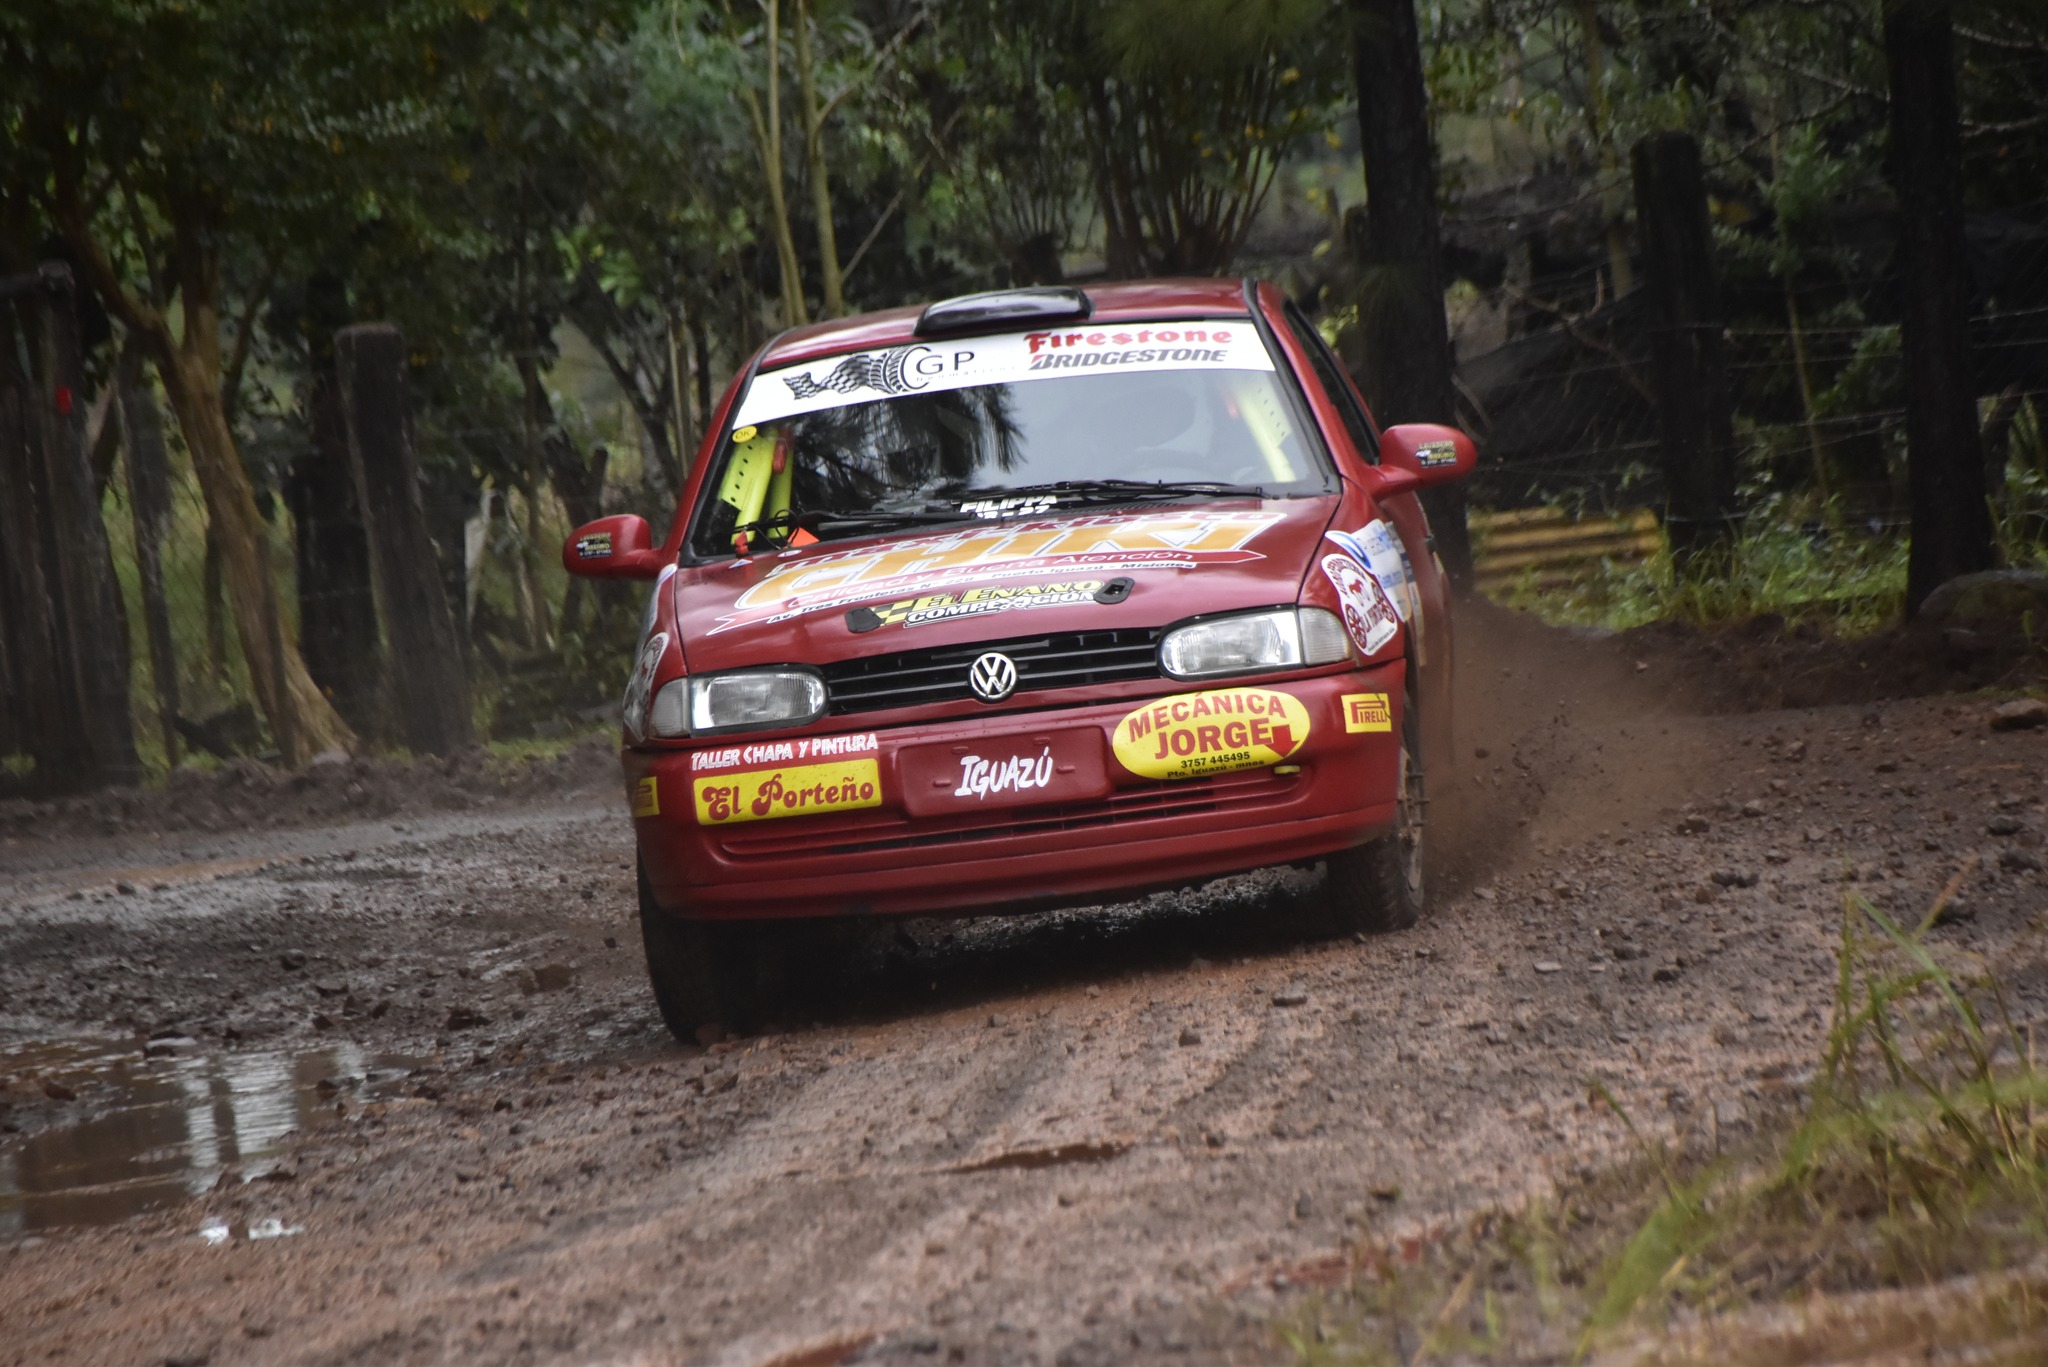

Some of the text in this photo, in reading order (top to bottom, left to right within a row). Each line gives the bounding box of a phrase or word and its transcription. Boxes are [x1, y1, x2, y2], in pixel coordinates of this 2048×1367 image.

[1023, 329, 1233, 354] Firestone
[1028, 348, 1228, 371] BRIDGESTONE
[960, 495, 1057, 513] FILIPPA
[787, 551, 1193, 609] Calidad y Buena Atención
[801, 603, 833, 613] Tres
[838, 585, 915, 604] Fronteras
[990, 568, 1044, 578] Puerto
[965, 580, 1102, 601] ENANO
[1128, 691, 1287, 743] MECÁNICA
[1350, 700, 1388, 724] PIRELLI
[691, 733, 879, 771] TALLER CHAPA Y PINTURA
[1155, 717, 1272, 760] JORGE
[954, 746, 1053, 800] IGUAZÚ
[1181, 751, 1250, 768] 3757 445495
[1191, 764, 1227, 775] Iguazú
[702, 773, 874, 821] El Porteño
